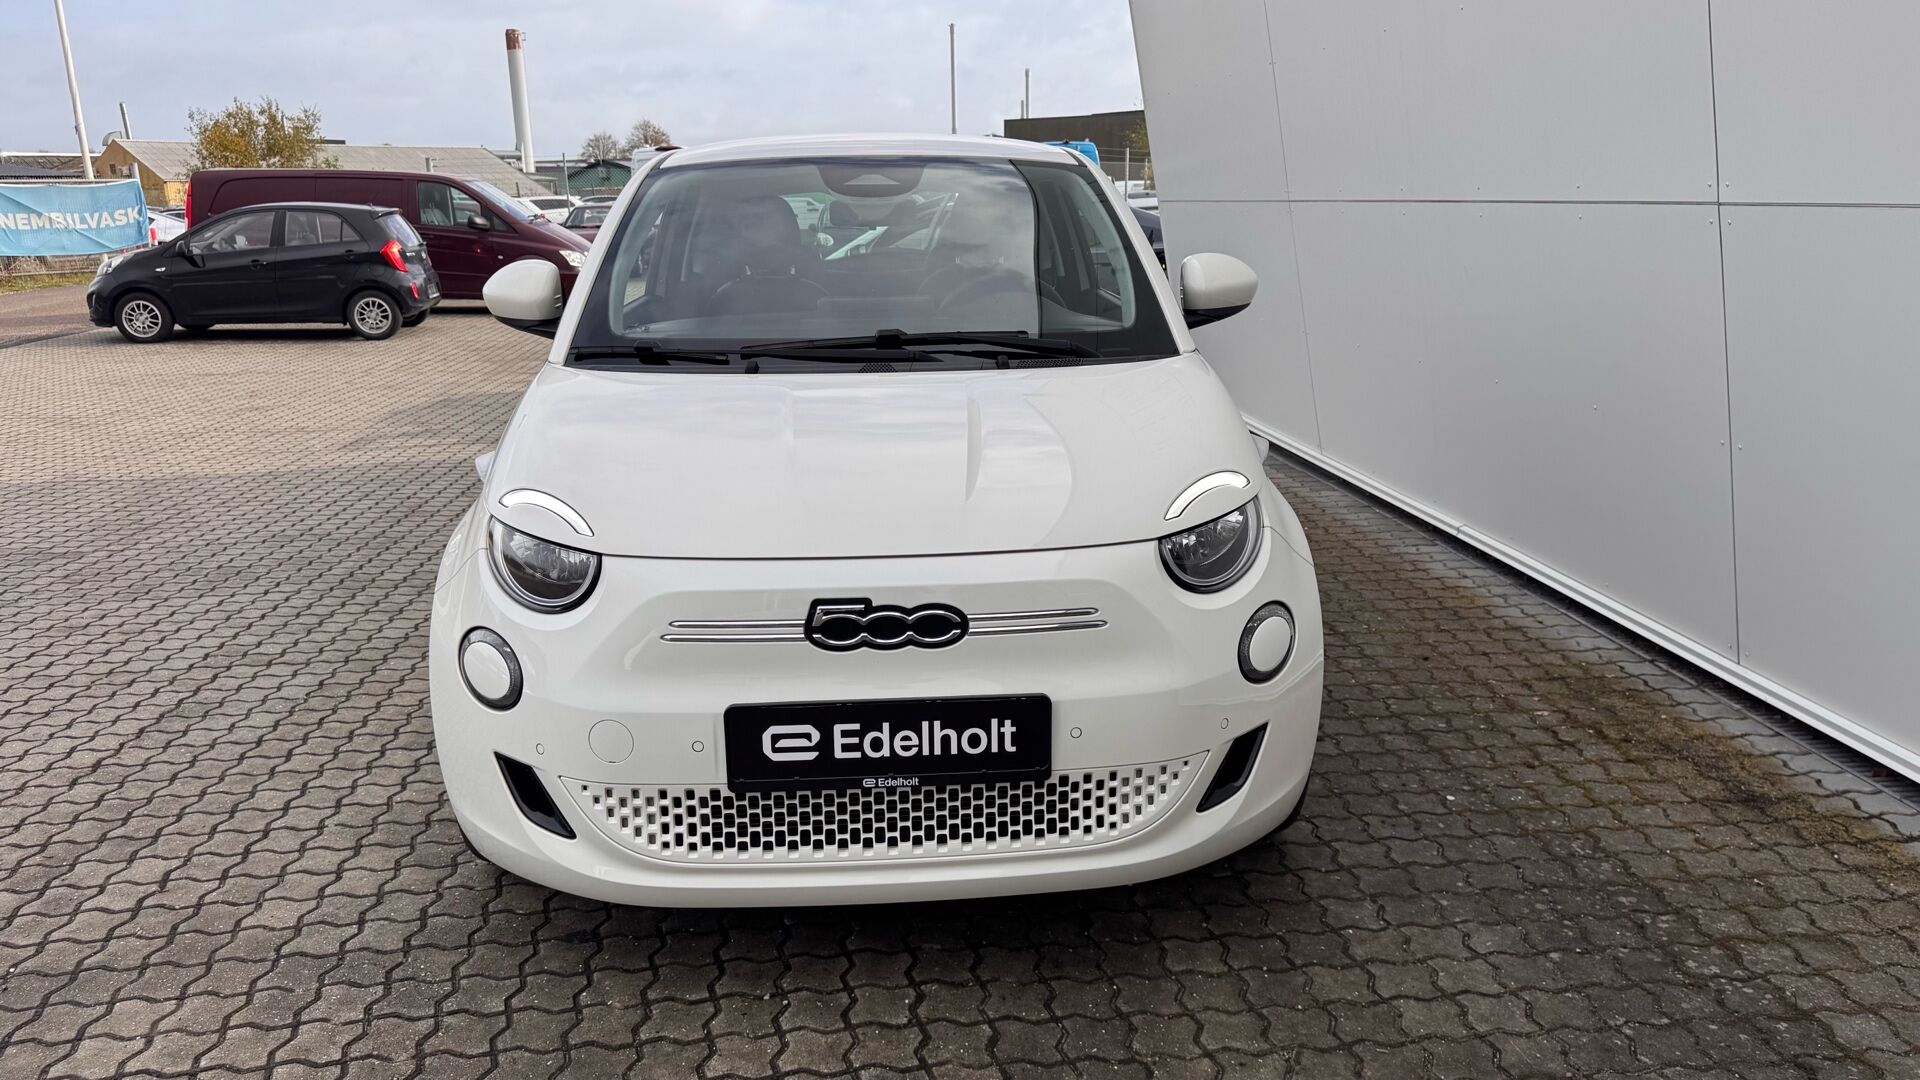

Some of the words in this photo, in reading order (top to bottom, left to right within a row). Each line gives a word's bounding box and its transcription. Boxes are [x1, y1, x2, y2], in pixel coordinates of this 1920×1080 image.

[0, 206, 143, 232] NEMBILVASK
[808, 601, 965, 648] 500
[832, 718, 1017, 760] Edelholt
[878, 777, 919, 787] Edelholt
